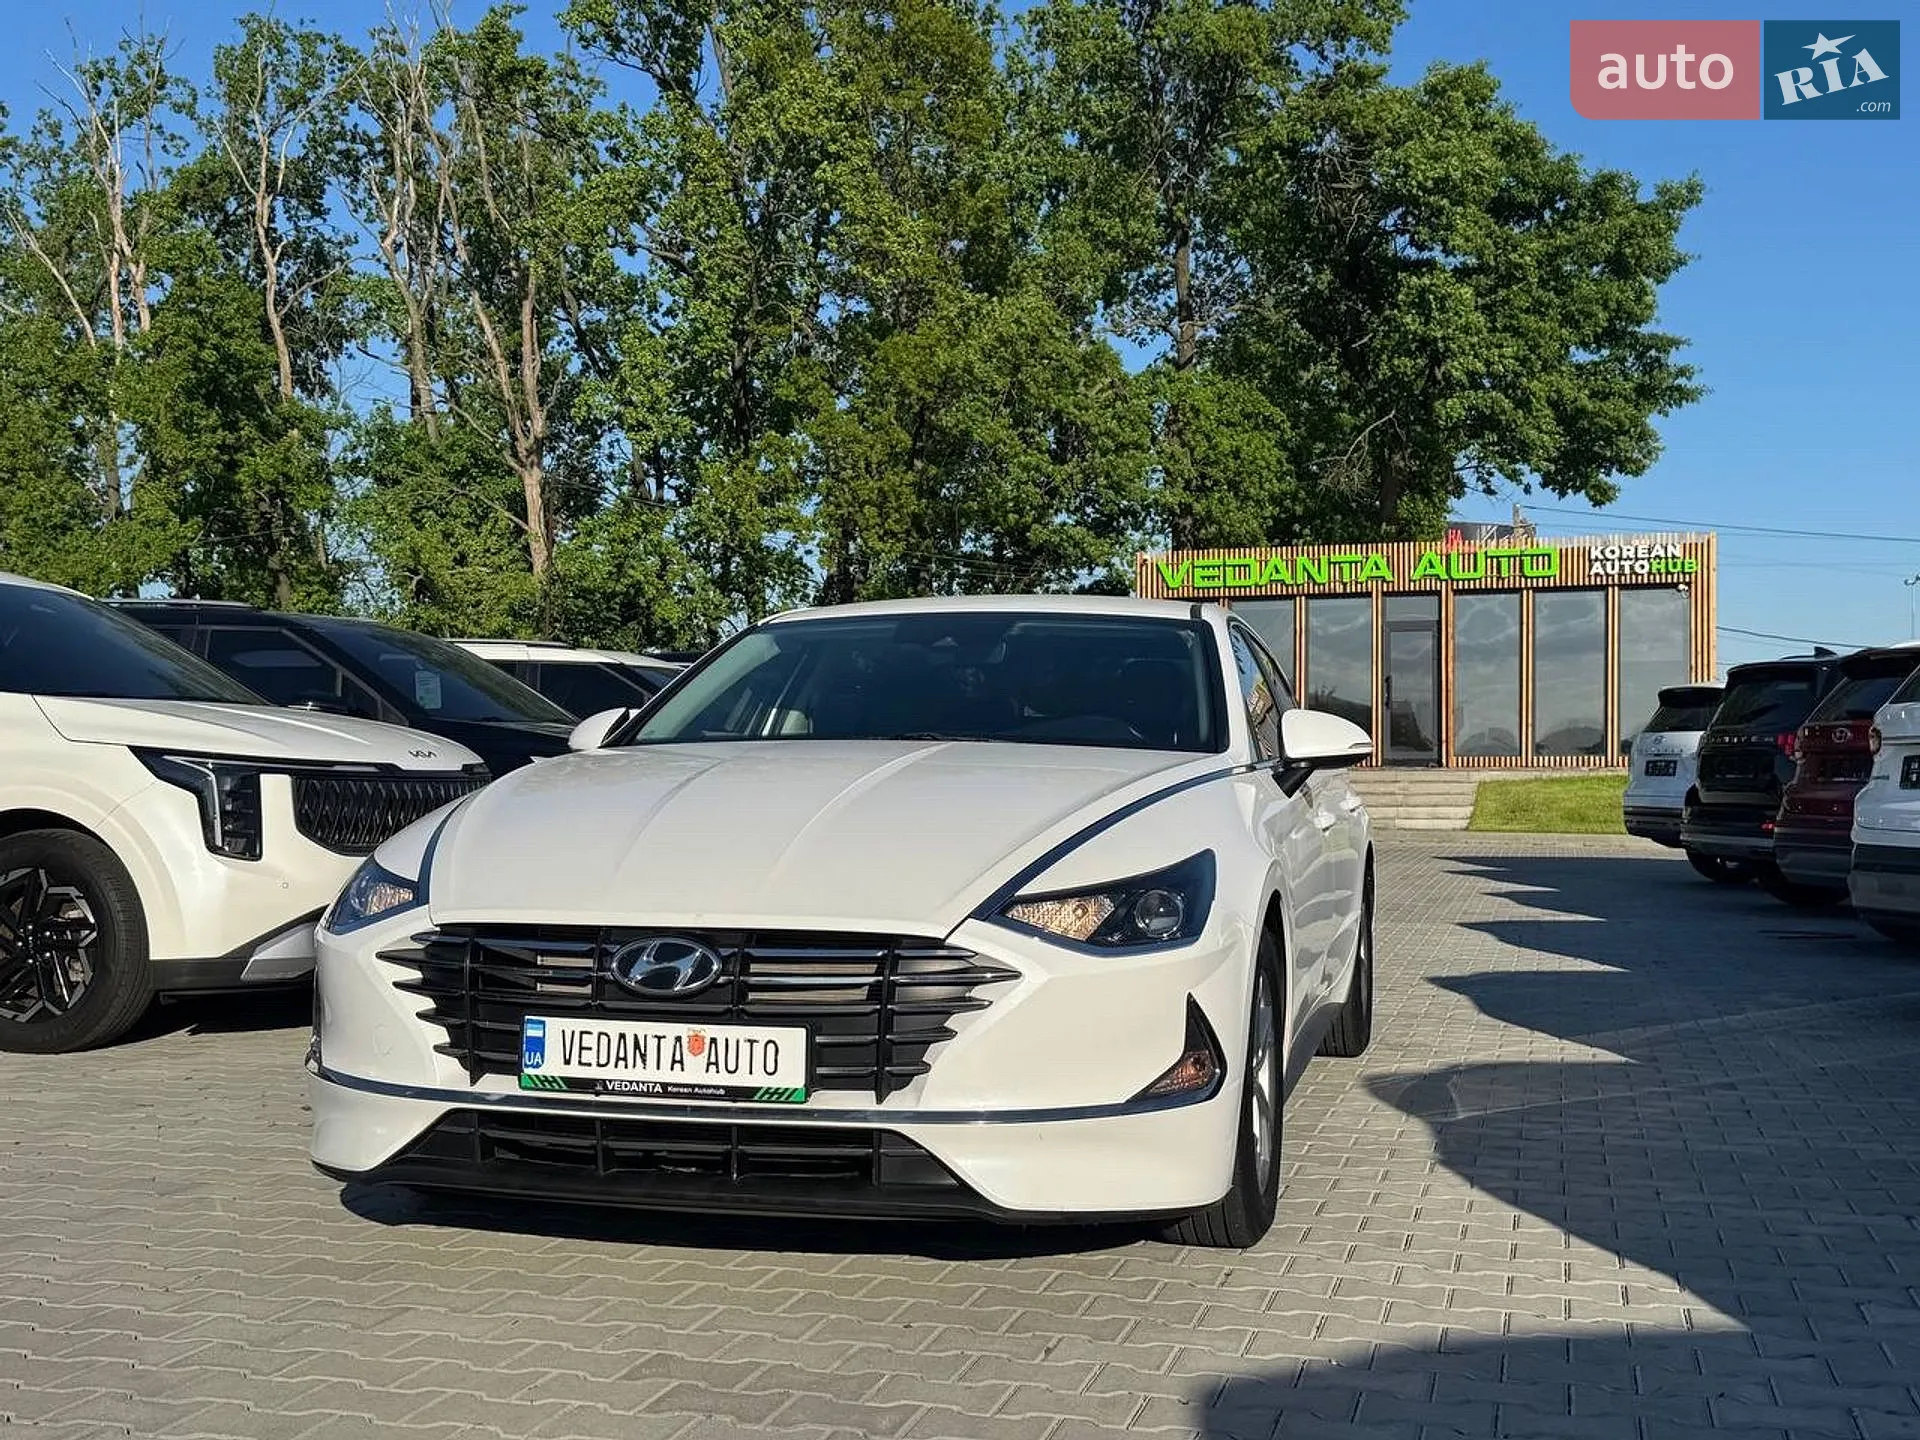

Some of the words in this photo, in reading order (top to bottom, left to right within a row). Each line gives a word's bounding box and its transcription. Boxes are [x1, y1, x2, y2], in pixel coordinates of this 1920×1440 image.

[1590, 543, 1681, 559] KOREAN
[1156, 552, 1394, 589] VEDANTA
[1411, 545, 1561, 582] AUTO
[1589, 558, 1698, 575] AUTOHUB
[525, 1051, 543, 1068] UA
[561, 1028, 685, 1073] VEDANTA
[705, 1036, 780, 1076] AUTO
[606, 1080, 663, 1094] VEDANTA
[667, 1085, 693, 1094] Korean
